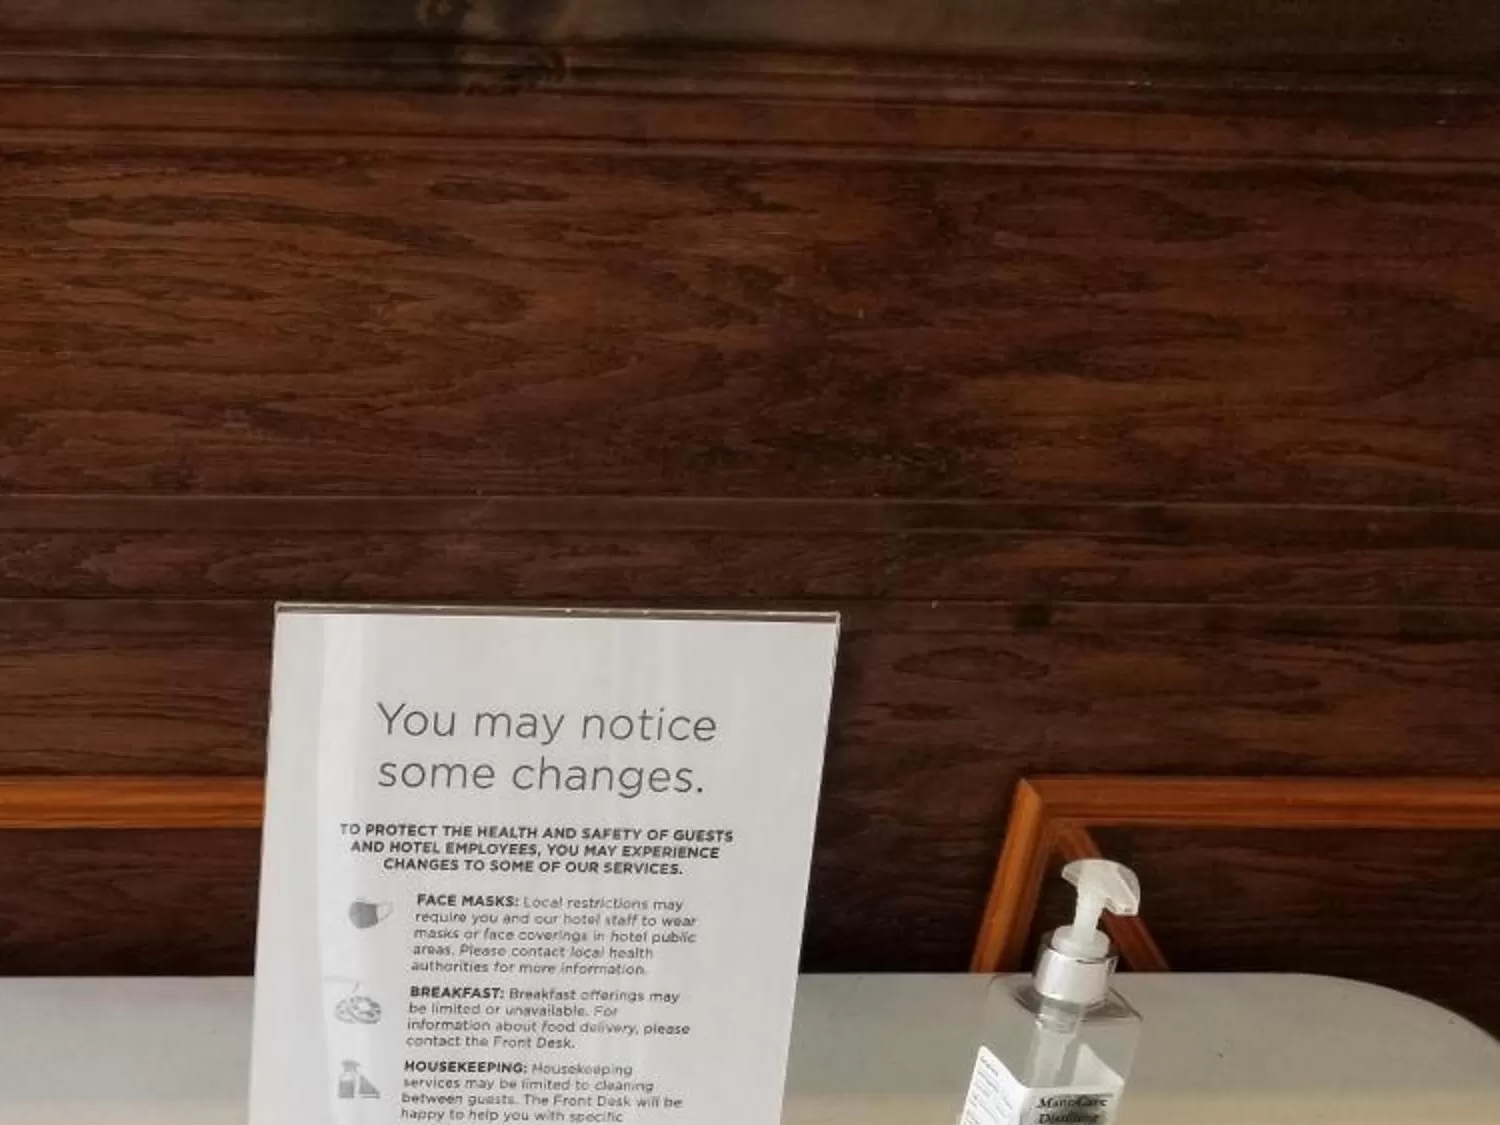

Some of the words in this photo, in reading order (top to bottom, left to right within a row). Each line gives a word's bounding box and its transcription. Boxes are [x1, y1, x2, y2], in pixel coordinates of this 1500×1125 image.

[377, 702, 455, 736] You
[475, 713, 564, 745] may
[582, 709, 716, 741] notice
[378, 763, 495, 788] some
[512, 756, 703, 798] changes.
[340, 824, 360, 834] TO
[366, 824, 438, 836] PROTECT
[442, 826, 472, 836] THE
[478, 826, 538, 838] HEALTH
[542, 828, 576, 839] AND
[582, 828, 642, 840] SAFETY
[647, 829, 668, 840] OF
[674, 830, 733, 842] GUESTS
[351, 841, 384, 852] AND
[390, 842, 440, 853] HOTEL
[446, 842, 540, 855] EMPLOYEES,
[548, 844, 578, 856] YOU
[584, 845, 616, 856] MAY
[622, 846, 720, 858] EXPERIENCE
[384, 858, 459, 870] CHANGES
[464, 860, 484, 871] TO
[490, 860, 534, 872] SOME
[539, 861, 560, 872] OF
[566, 862, 599, 872] OUR
[604, 862, 682, 874] SERVICES.
[417, 894, 456, 906] FACE
[462, 896, 518, 906] MASKS:
[524, 897, 562, 908] Local
[568, 899, 647, 908] restrictions
[654, 902, 682, 911] may
[416, 913, 466, 922] require
[472, 914, 498, 925] you
[503, 914, 529, 924] and
[534, 916, 558, 924] our
[564, 914, 600, 924] hotel
[606, 914, 638, 925] staff
[642, 916, 656, 926] to
[662, 918, 696, 926] wear
[414, 929, 459, 938] masks
[464, 931, 478, 939] or
[484, 928, 514, 940] face
[518, 931, 587, 942] coverings
[611, 932, 647, 942] hotel
[652, 931, 696, 943] public
[413, 946, 453, 955] areas.
[460, 944, 506, 956] Please
[512, 947, 564, 957] contact
[571, 947, 604, 958] local
[610, 948, 652, 958] health
[411, 961, 488, 972] authorities
[494, 961, 515, 972] for
[519, 964, 556, 973] more
[410, 986, 504, 998] BREAKFAST:
[510, 988, 576, 1000] Breakfast
[582, 991, 644, 1001] offerings
[650, 994, 679, 1004] may
[409, 1002, 426, 1014] be
[432, 1004, 480, 1014] limited
[486, 1006, 499, 1014] or
[506, 1004, 588, 1016] unavailable.
[595, 1006, 617, 1016] For
[408, 1019, 490, 1030] information
[496, 1022, 536, 1033] about
[542, 1021, 575, 1032] food
[580, 1023, 638, 1035] delivery,
[644, 1024, 690, 1034] please
[406, 1036, 460, 1046] contact
[466, 1036, 488, 1046] the
[494, 1036, 531, 1048] Front
[536, 1037, 574, 1048] Desk.
[404, 1061, 527, 1073] HOUSEKEEPING:
[532, 1064, 632, 1075] Housekeeping
